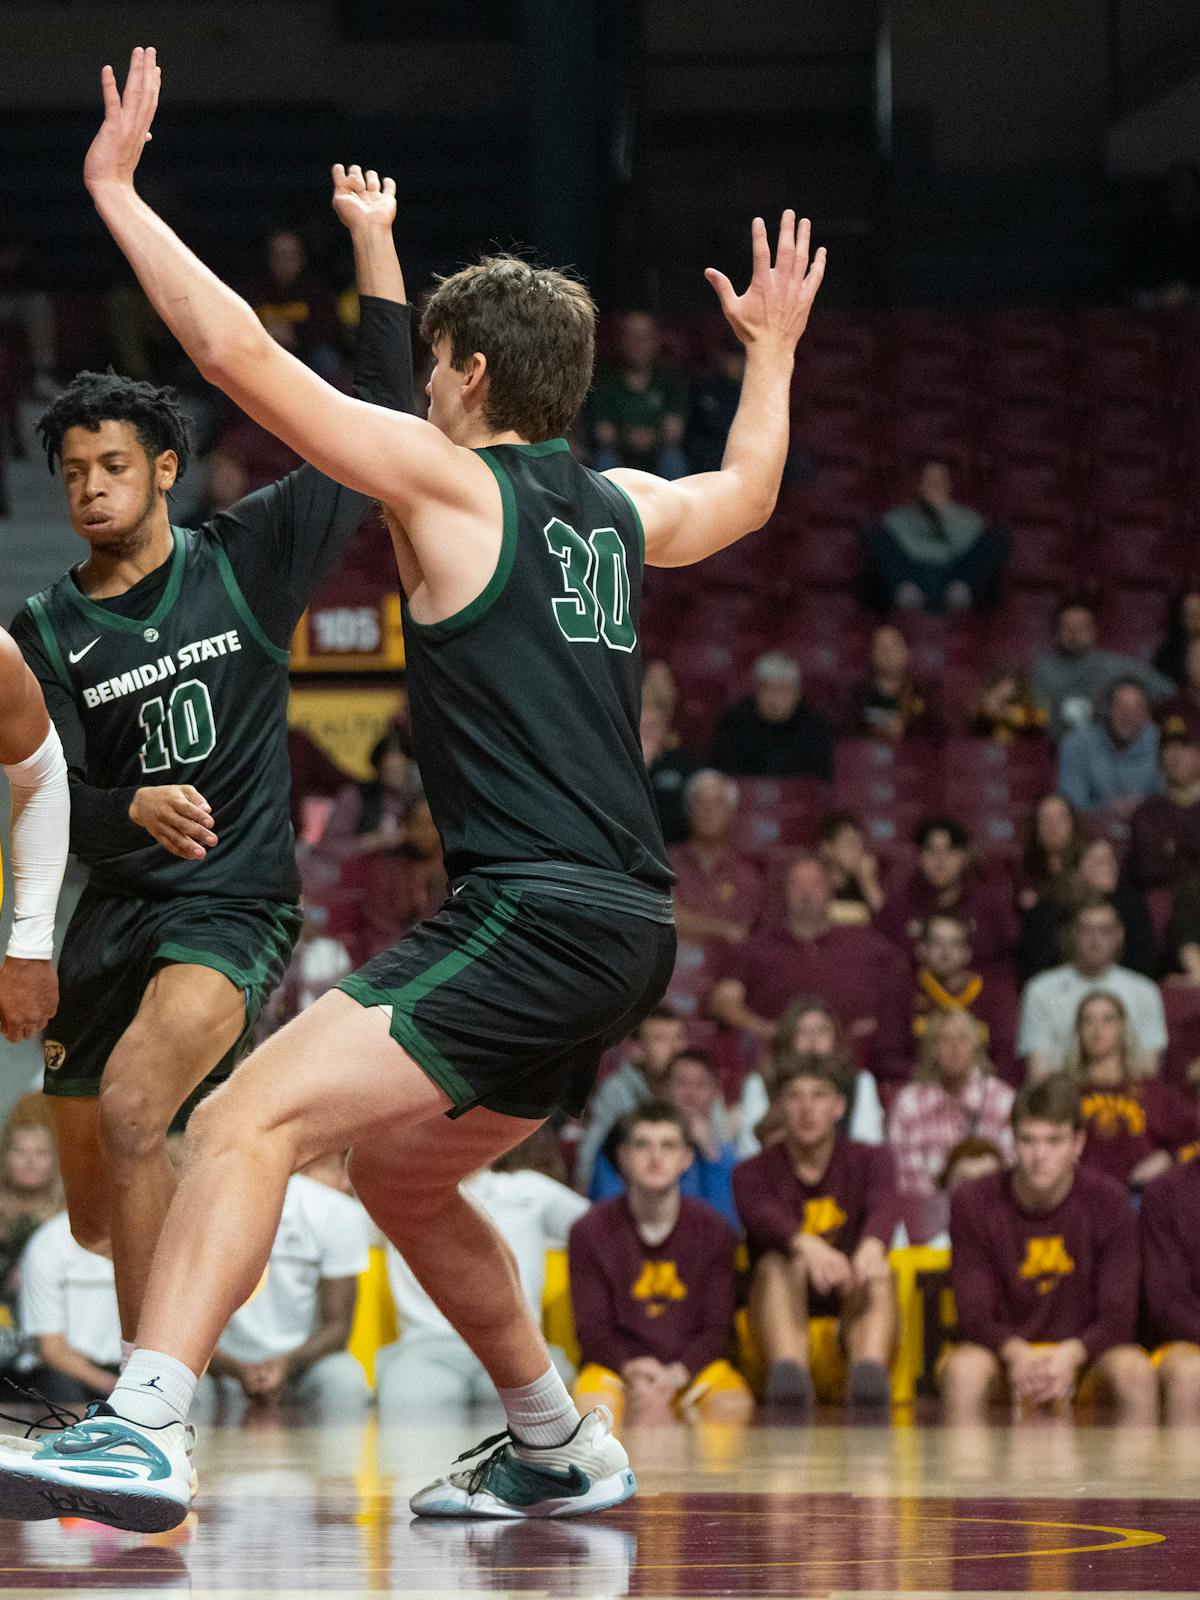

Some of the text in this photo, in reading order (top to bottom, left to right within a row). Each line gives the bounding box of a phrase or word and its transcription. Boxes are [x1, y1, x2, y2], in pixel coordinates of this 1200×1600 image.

[543, 516, 637, 654] 30
[82, 629, 242, 709] BEMIDJI STATE
[139, 678, 217, 773] 10
